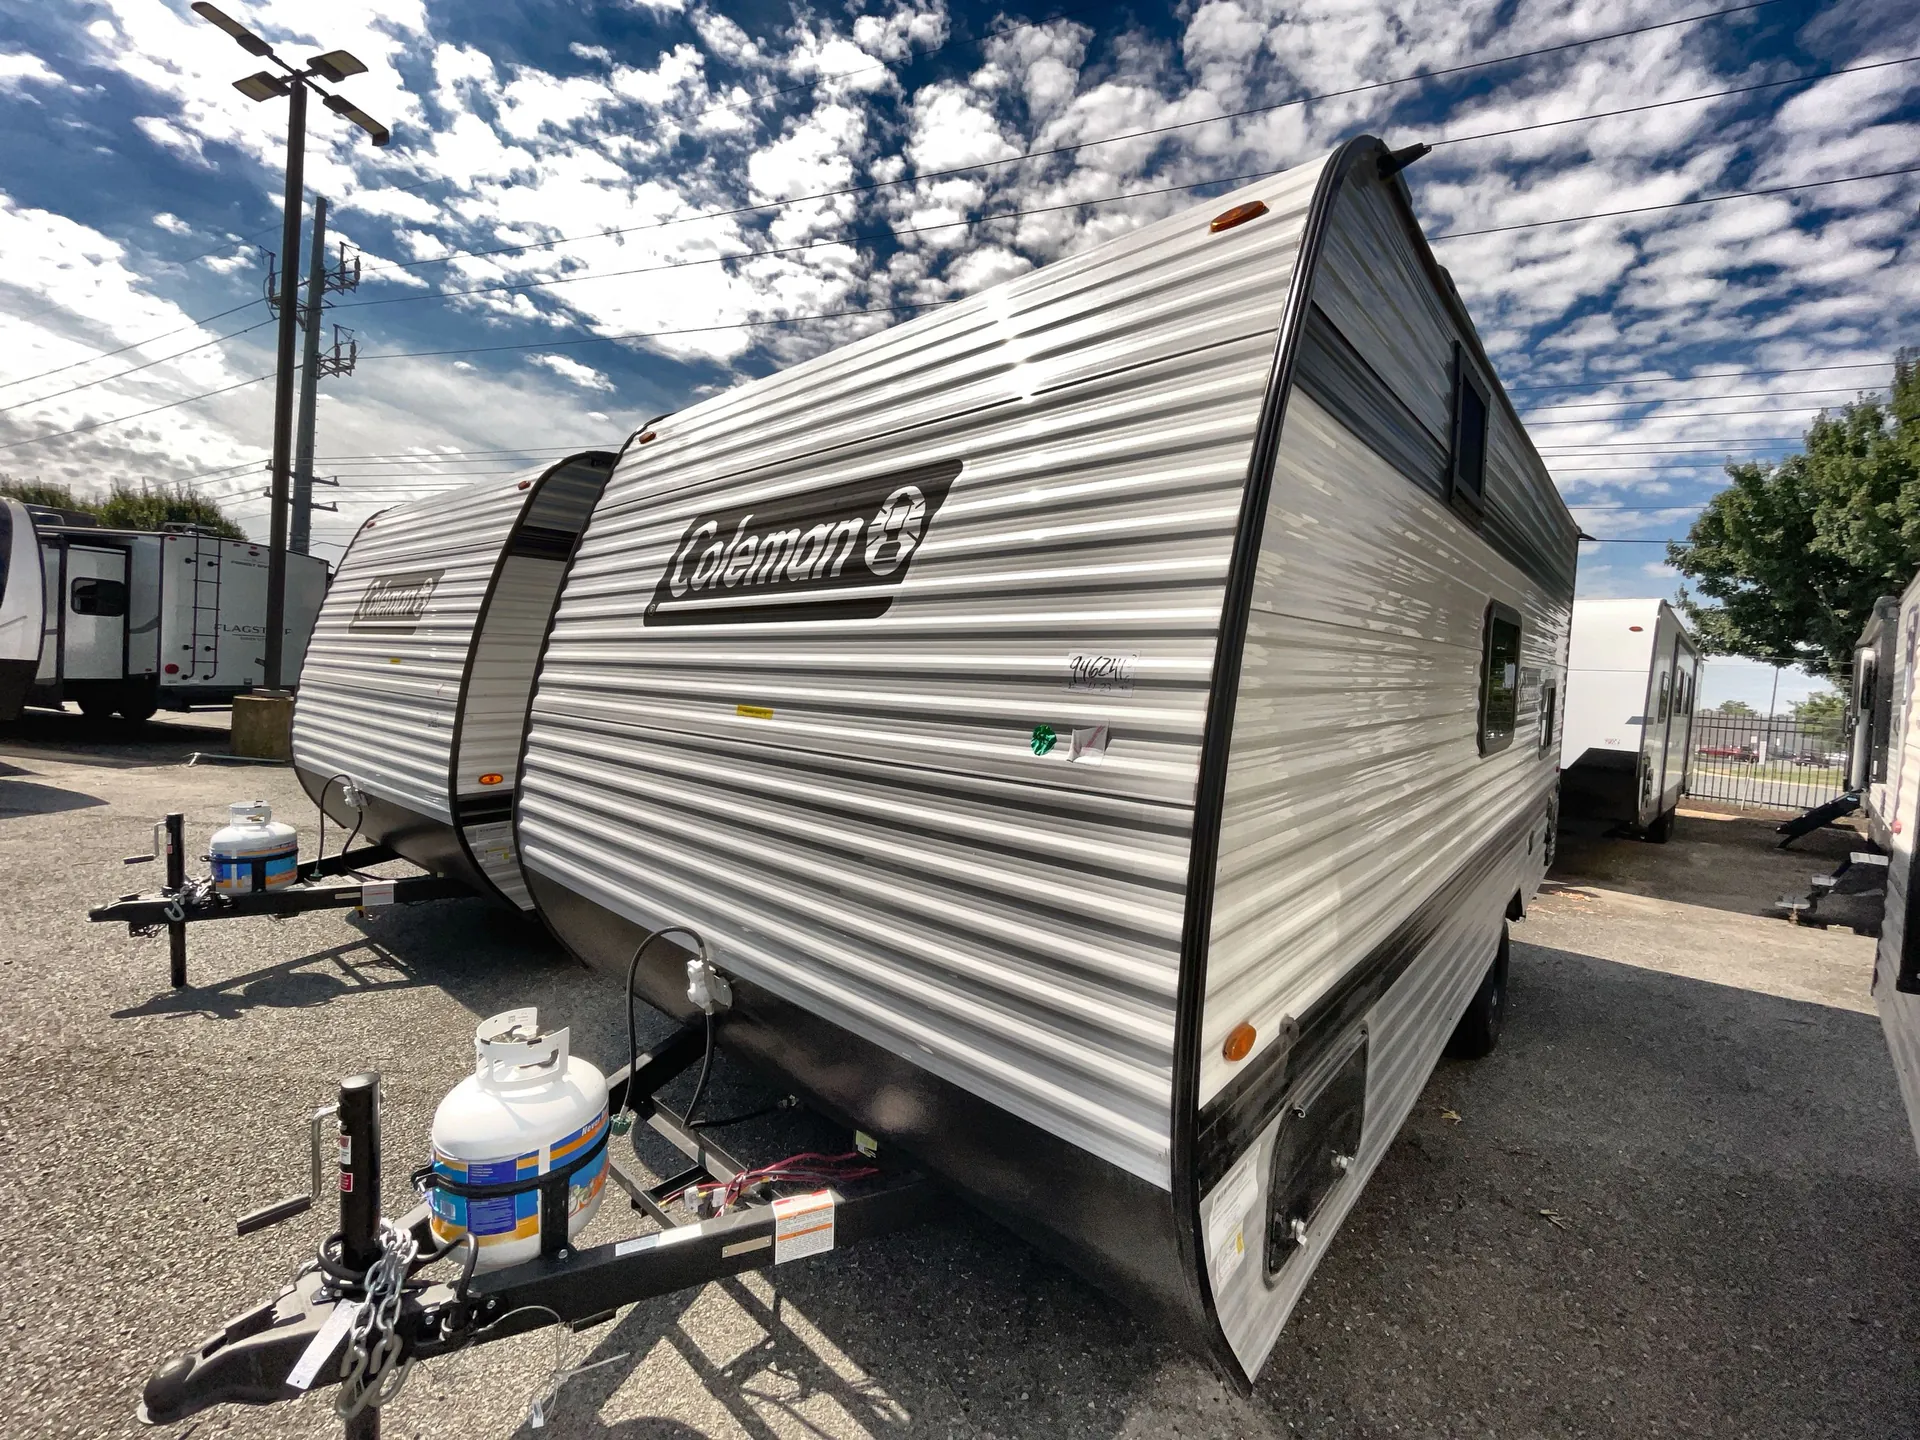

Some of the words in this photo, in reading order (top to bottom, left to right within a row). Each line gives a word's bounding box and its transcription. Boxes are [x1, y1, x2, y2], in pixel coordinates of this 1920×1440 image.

[669, 514, 864, 598] Coleman
[359, 579, 419, 620] Coleman
[214, 623, 293, 636] FLAGSTF
